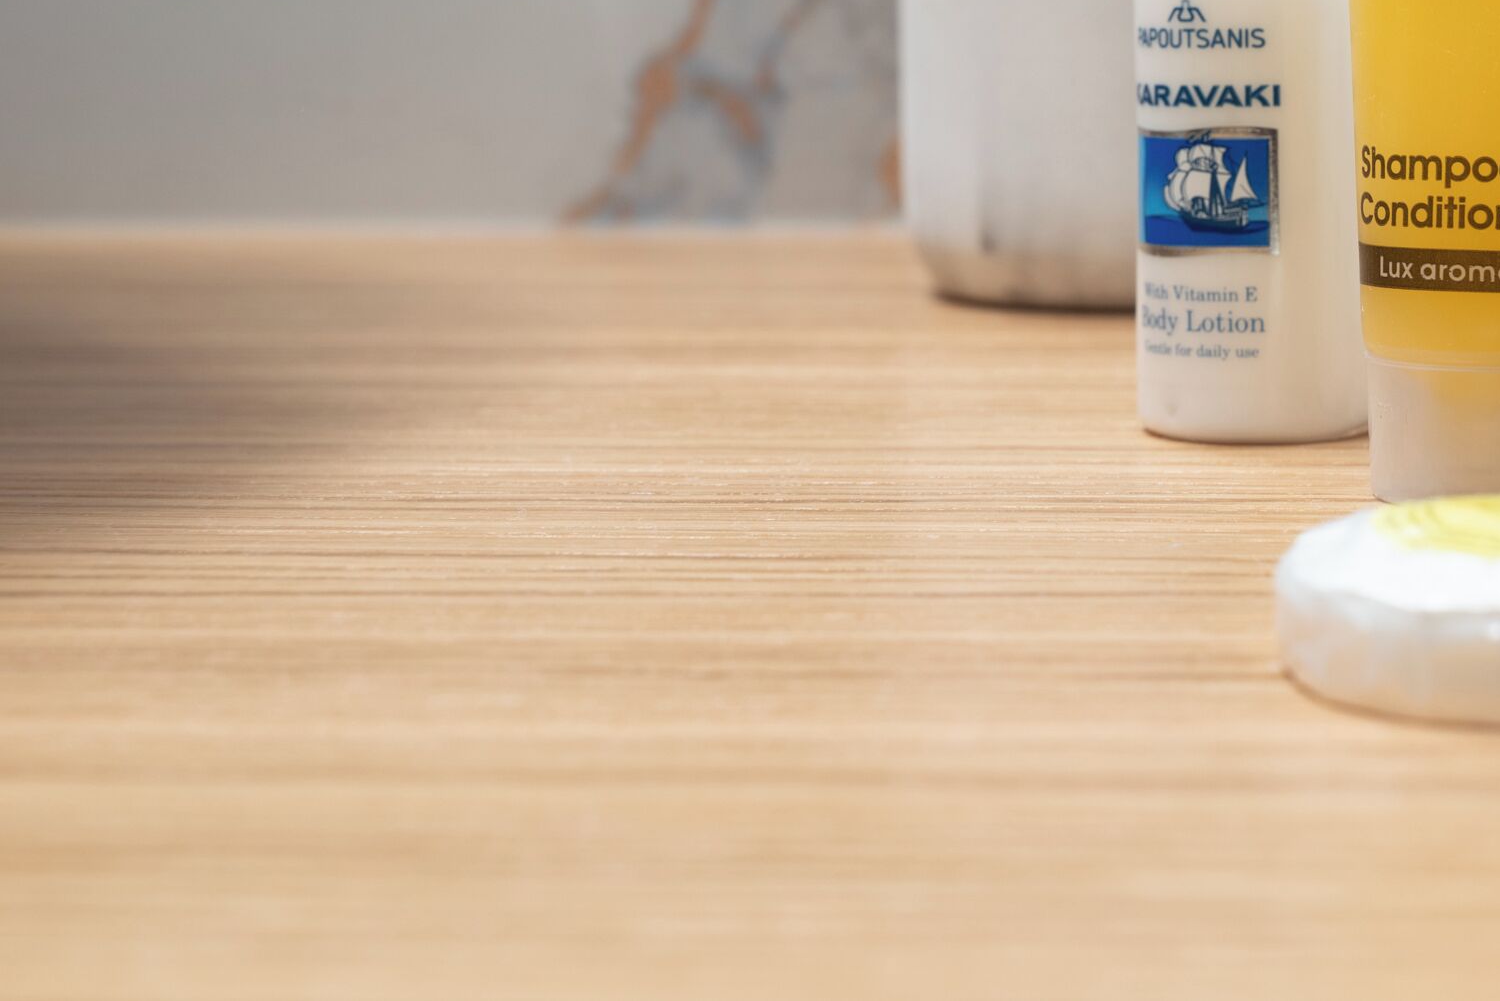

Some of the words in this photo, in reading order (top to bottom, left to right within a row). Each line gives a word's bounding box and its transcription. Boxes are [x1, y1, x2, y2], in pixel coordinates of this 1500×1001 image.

[1379, 255, 1413, 279] Lux
[1173, 284, 1239, 303] Vitamin
[1245, 285, 1258, 303] E
[1142, 304, 1178, 336] Body
[1186, 309, 1266, 334] Lotion
[1174, 343, 1192, 357] for
[1196, 344, 1231, 361] daily
[1235, 346, 1260, 359] use
